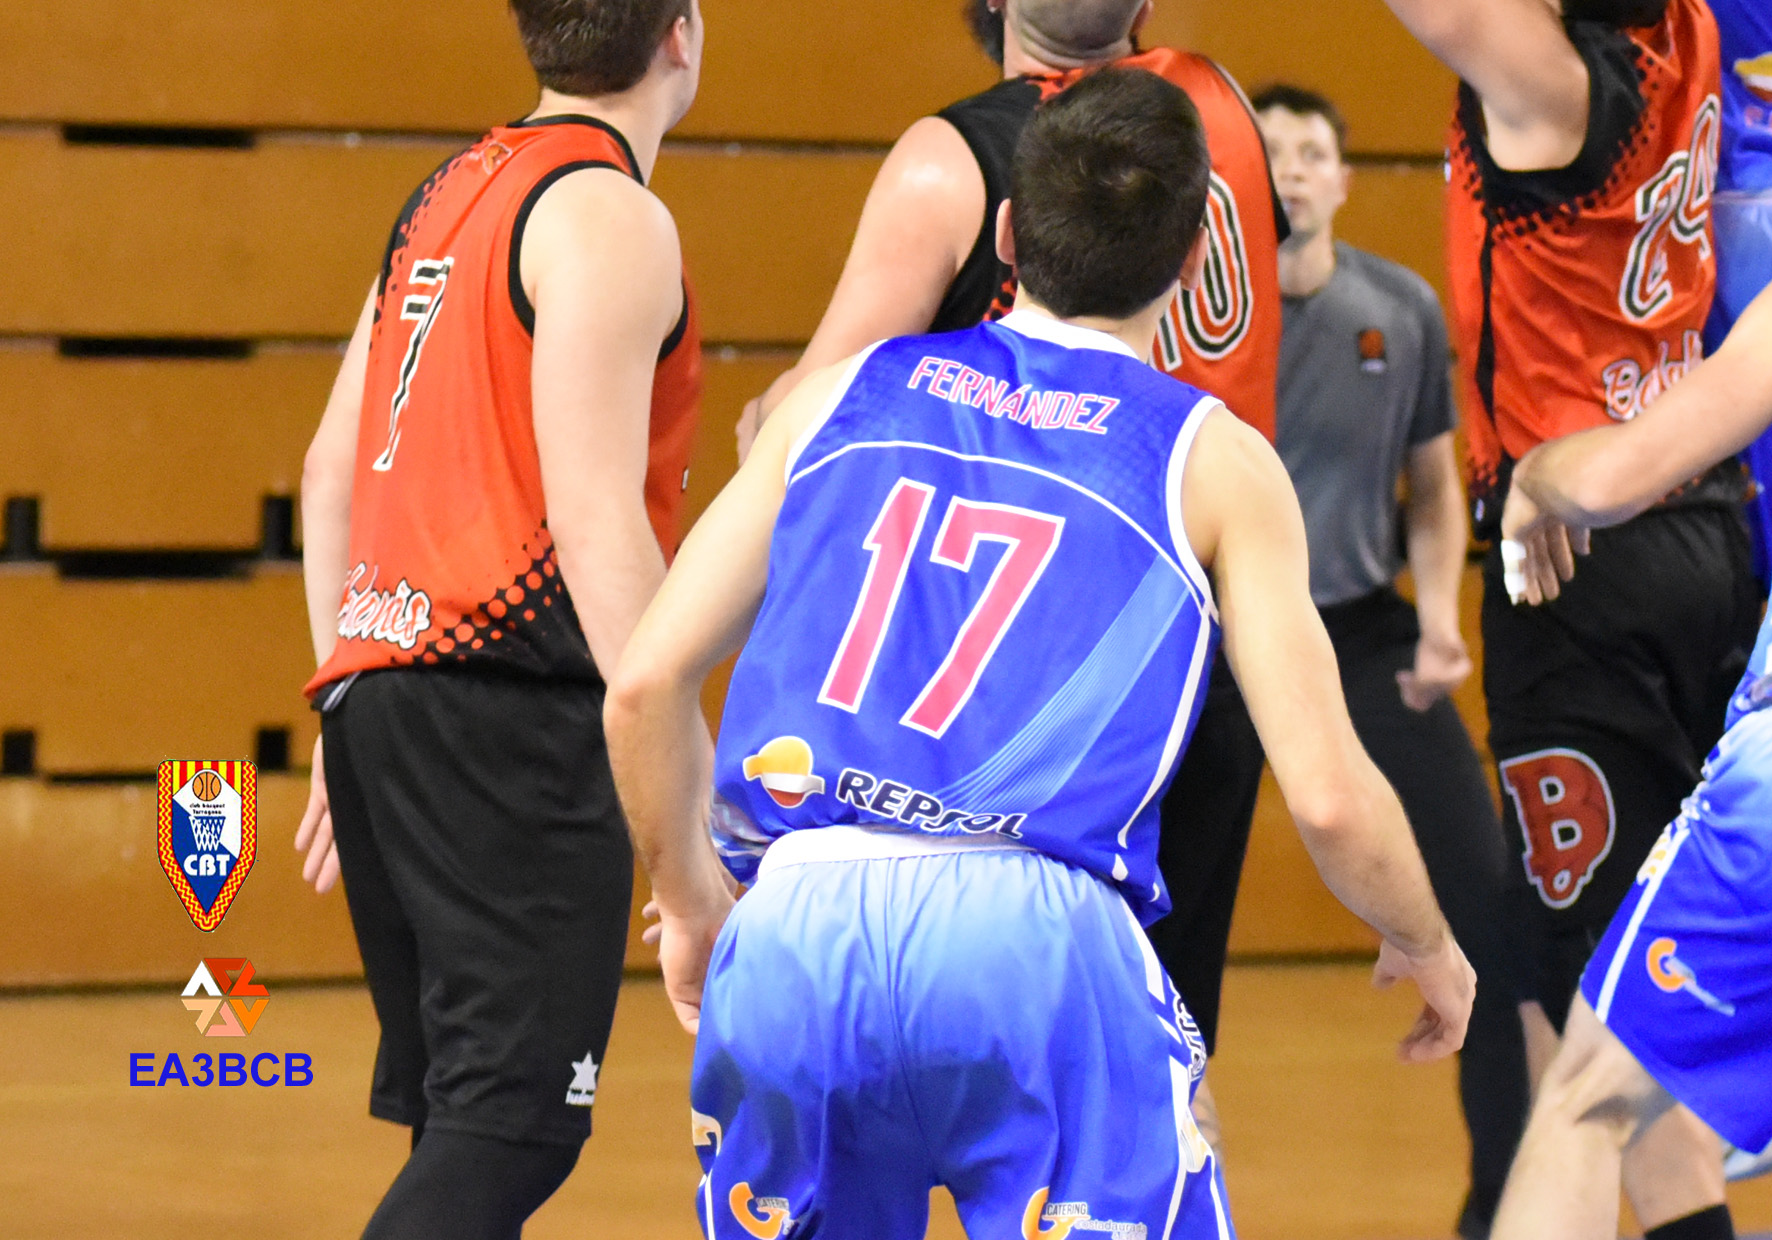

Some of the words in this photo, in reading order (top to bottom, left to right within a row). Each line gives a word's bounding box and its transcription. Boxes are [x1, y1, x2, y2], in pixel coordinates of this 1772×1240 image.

[907, 356, 1120, 435] FERNÁNDEZ
[817, 476, 1066, 739] 17
[837, 766, 1027, 841] REPSOL
[1047, 1203, 1087, 1217] CATERING
